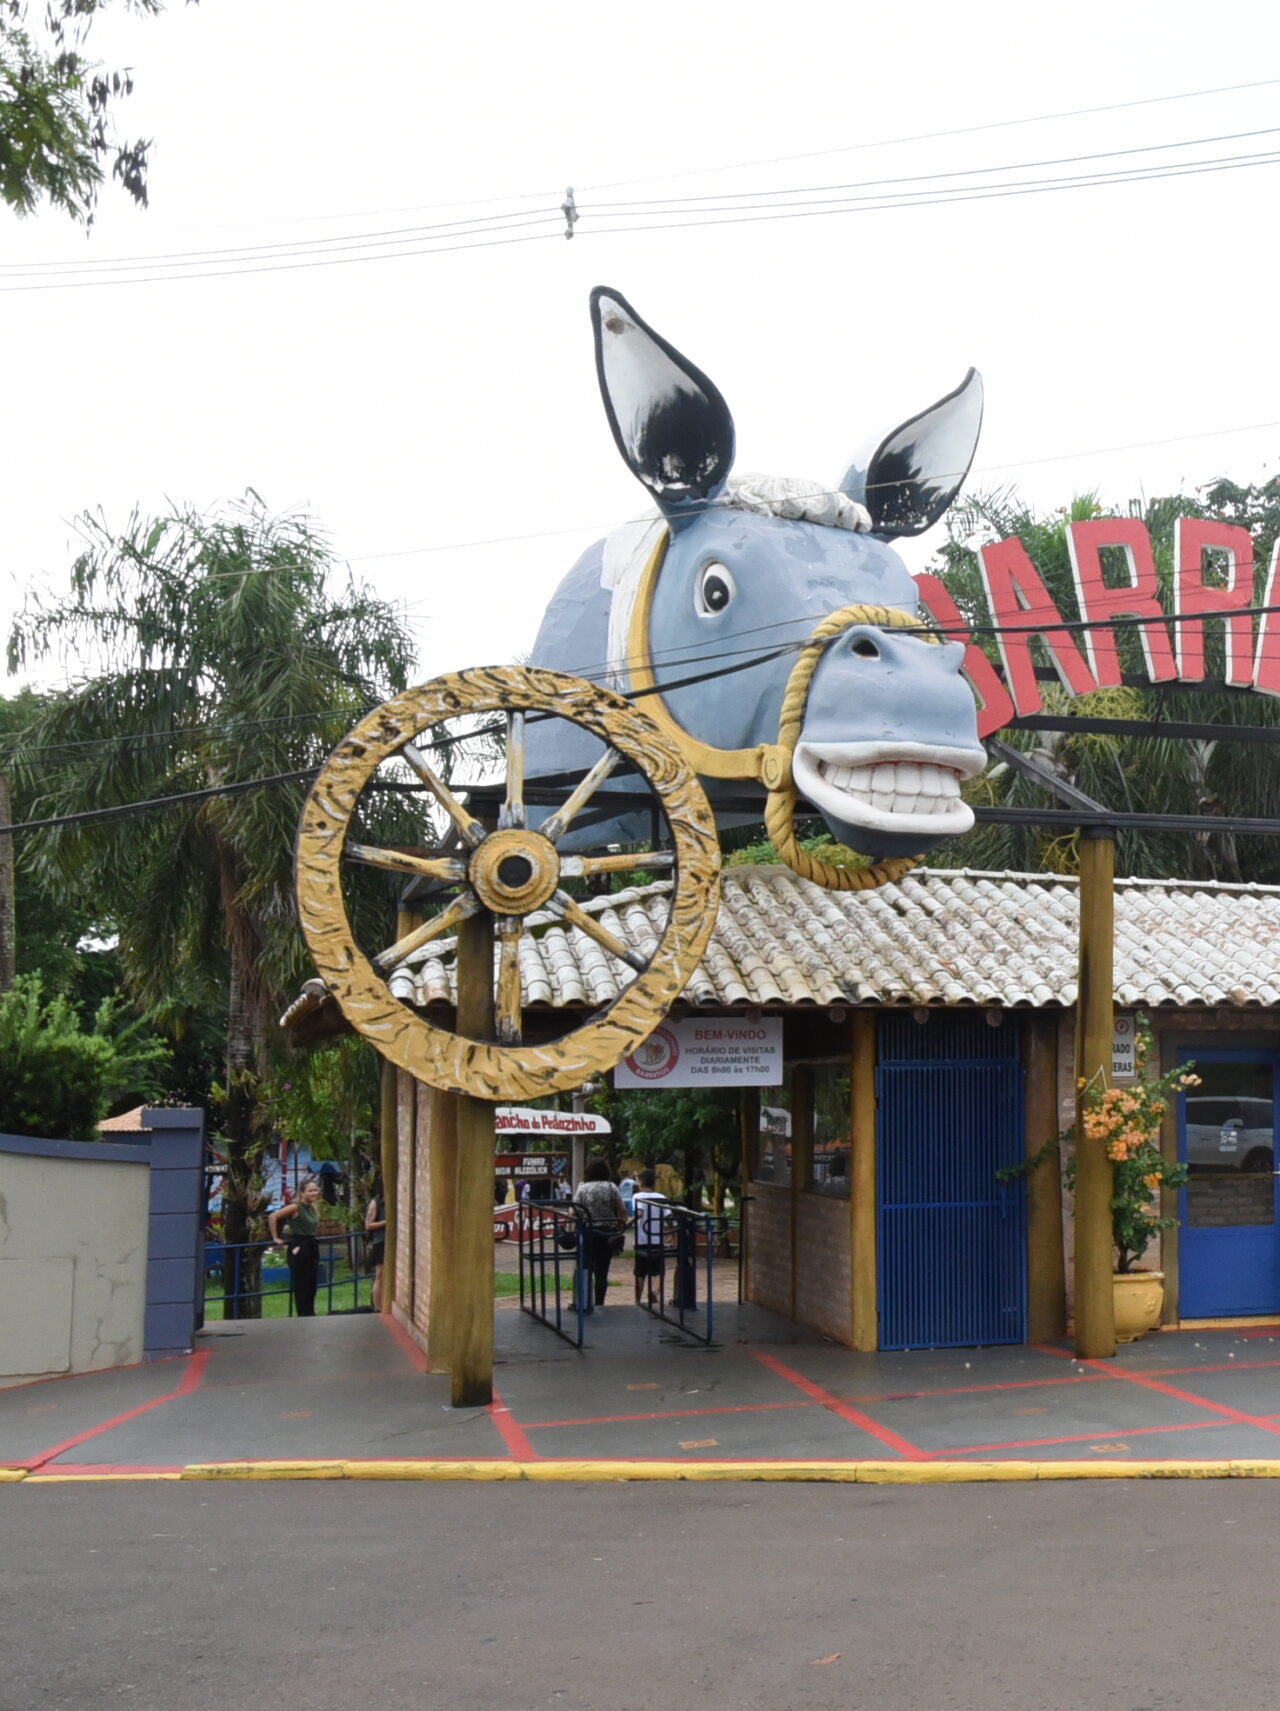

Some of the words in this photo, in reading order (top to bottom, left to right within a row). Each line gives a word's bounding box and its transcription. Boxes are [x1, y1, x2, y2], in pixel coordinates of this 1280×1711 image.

[694, 1030, 766, 1041] BEM-VINDO
[684, 1046, 727, 1055] HORÁRIO
[728, 1046, 740, 1055] DE
[741, 1046, 775, 1055] VISITAS
[700, 1056, 760, 1065] DIARIAMENTE
[690, 1066, 709, 1074] DAS
[711, 1065, 731, 1074] 8h00
[746, 1065, 770, 1073] 17h00
[532, 1116, 541, 1129] do
